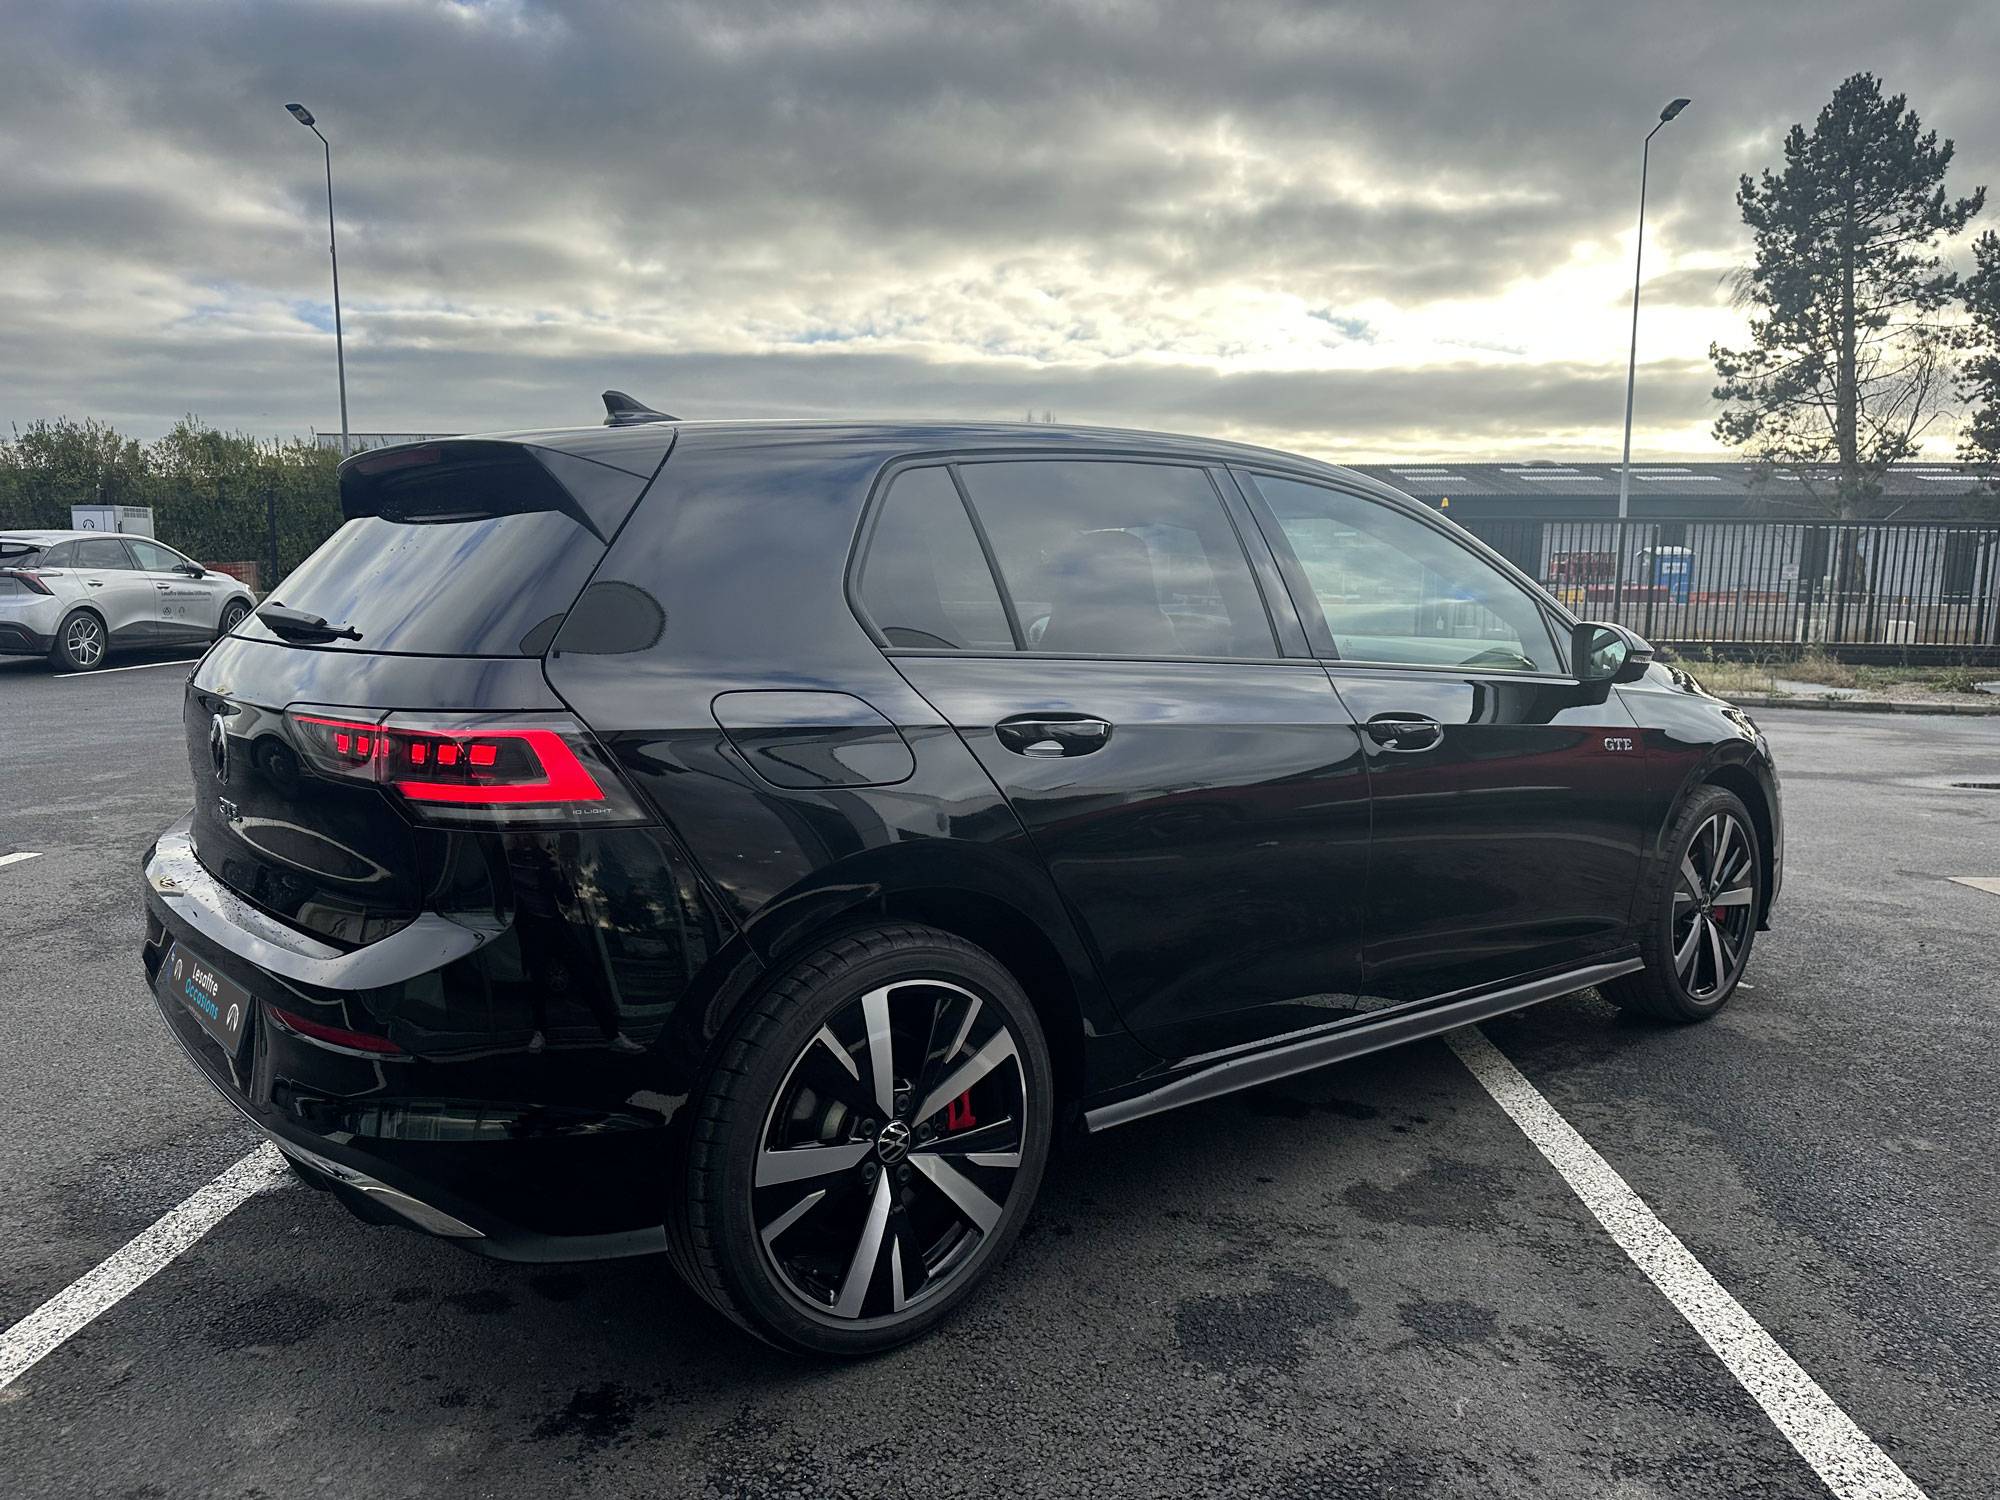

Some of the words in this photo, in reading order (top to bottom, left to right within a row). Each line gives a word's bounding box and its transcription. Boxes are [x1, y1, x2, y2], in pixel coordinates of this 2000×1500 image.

[1604, 737, 1633, 751] GTE
[192, 962, 218, 997] Lesaffre
[185, 978, 219, 1020] Occasions
